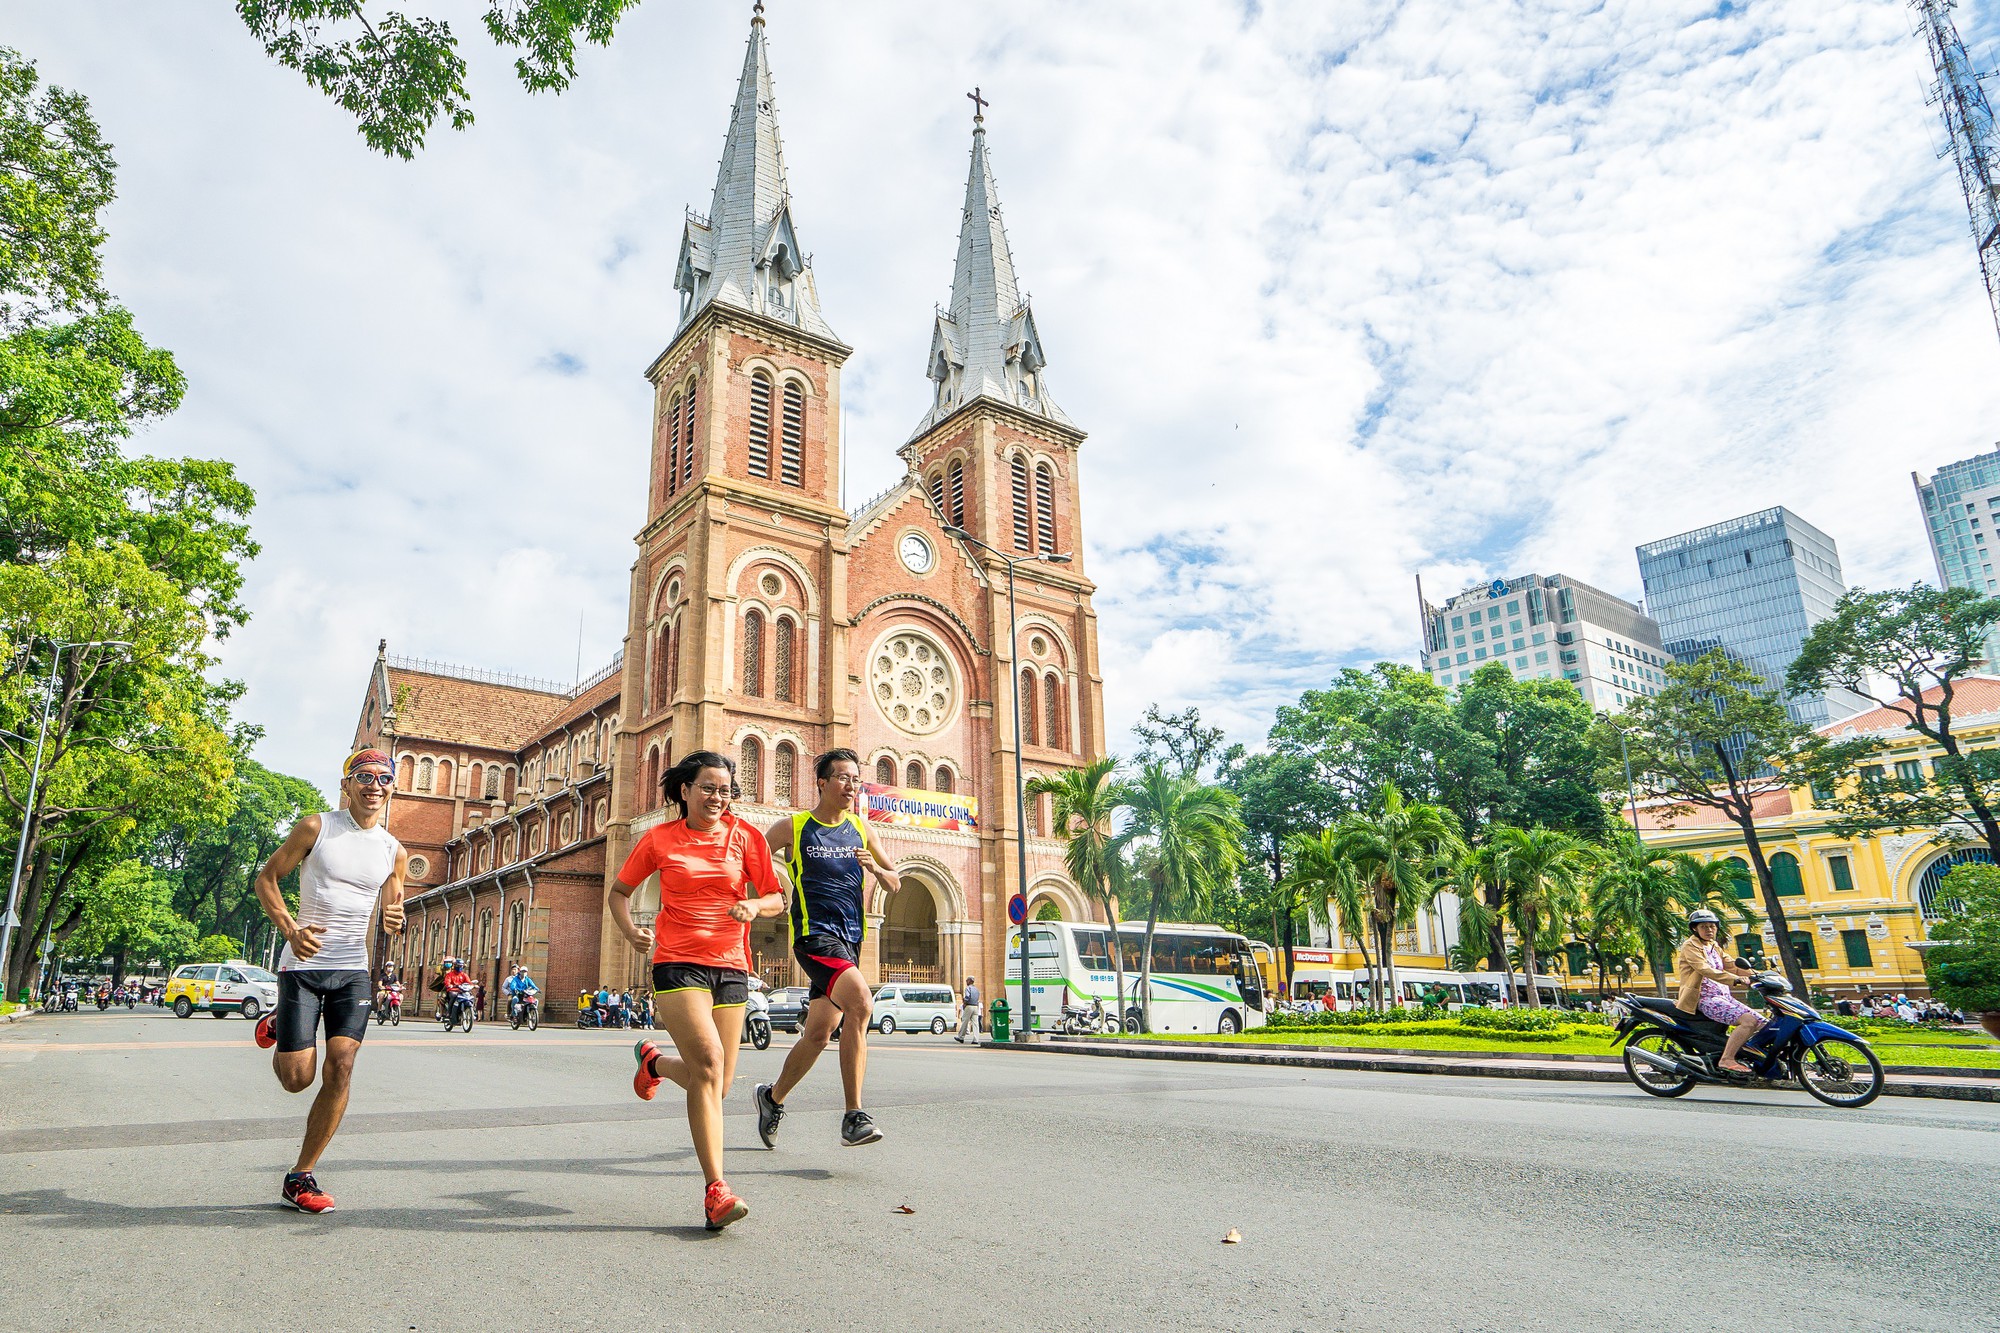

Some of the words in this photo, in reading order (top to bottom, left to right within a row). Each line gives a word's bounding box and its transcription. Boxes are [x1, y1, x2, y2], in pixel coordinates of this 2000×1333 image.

[924, 802, 947, 821] PHỤC
[949, 806, 969, 820] SINH
[806, 851, 832, 859] YOUR
[833, 851, 858, 859] LIMIT
[1296, 953, 1330, 962] McDonald's
